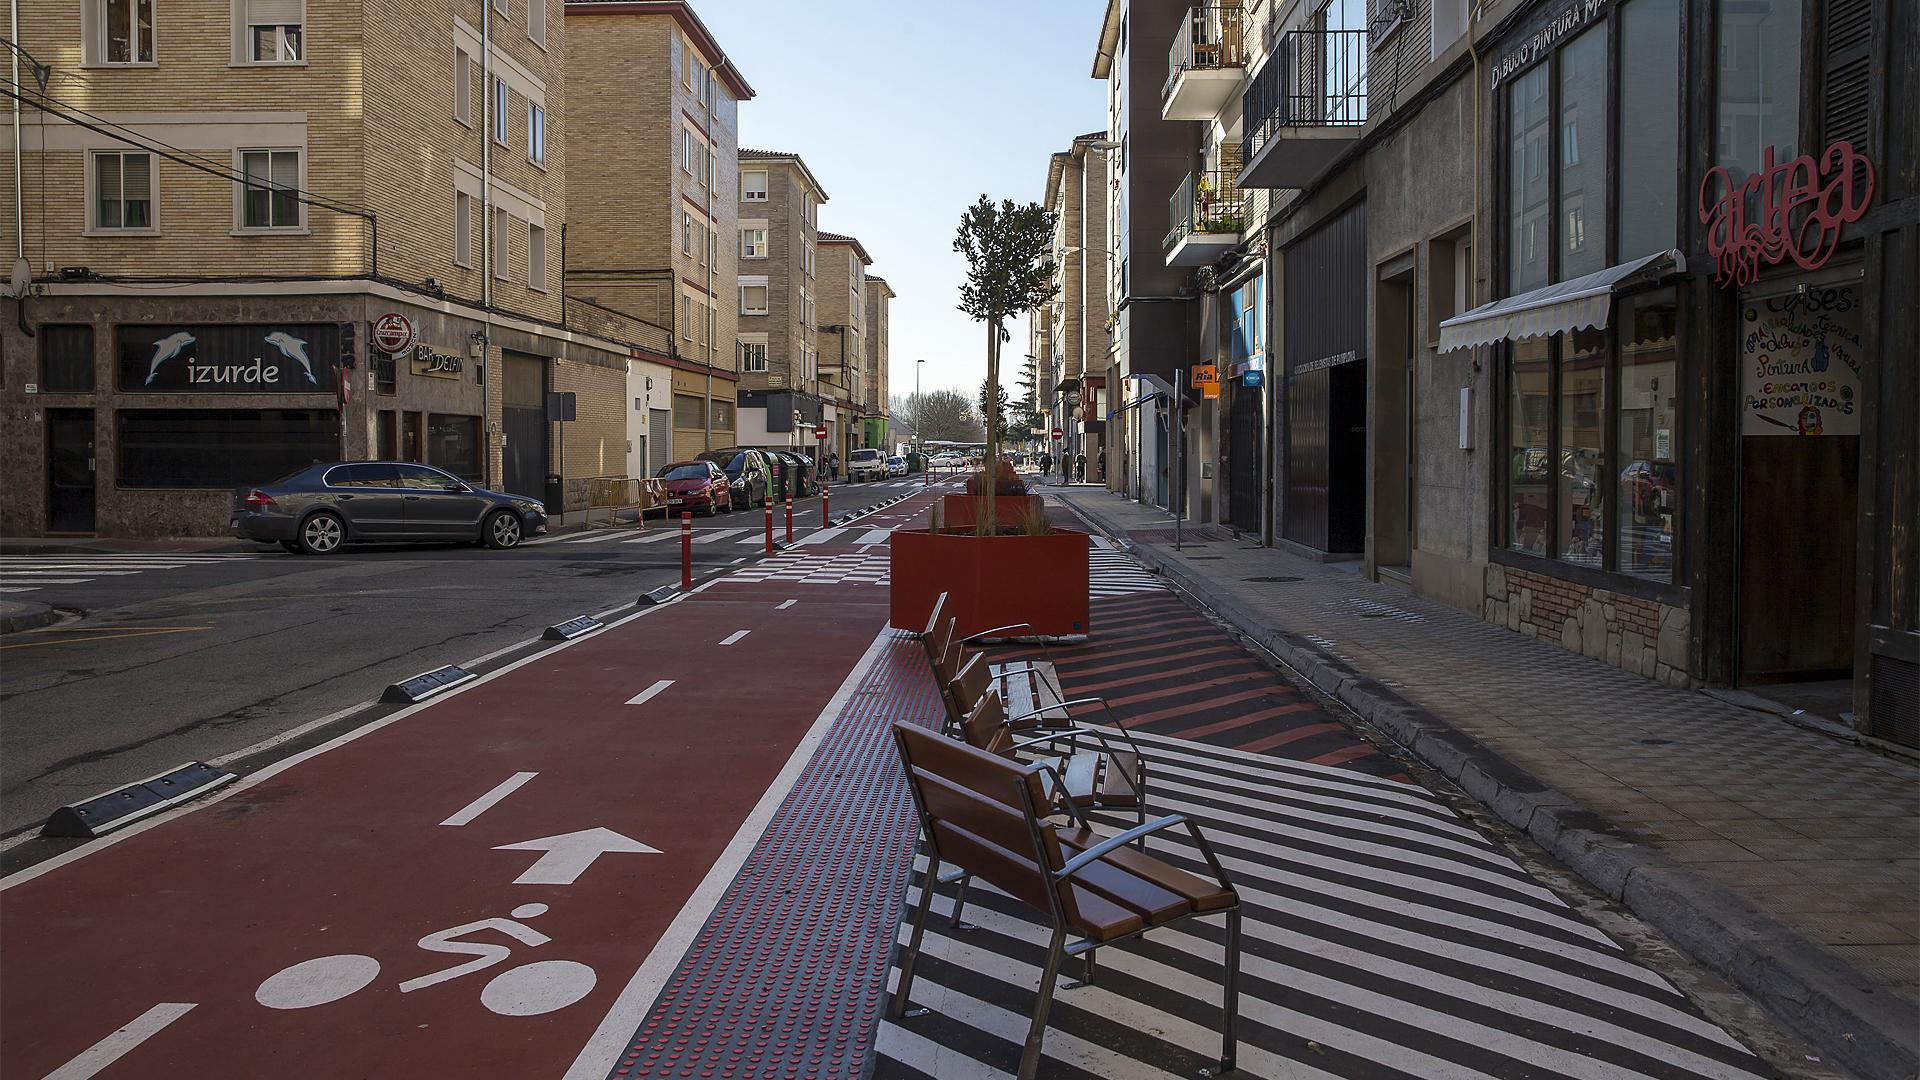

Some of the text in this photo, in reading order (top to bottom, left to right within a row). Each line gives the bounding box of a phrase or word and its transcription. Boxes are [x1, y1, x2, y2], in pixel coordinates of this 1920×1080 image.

[1491, 43, 1529, 90] DIBUJO
[1532, 4, 1580, 61] PINTURA
[1698, 140, 1876, 270] artea
[1714, 245, 1760, 290] 1981
[187, 356, 279, 384] izurde
[418, 345, 434, 361] BAR
